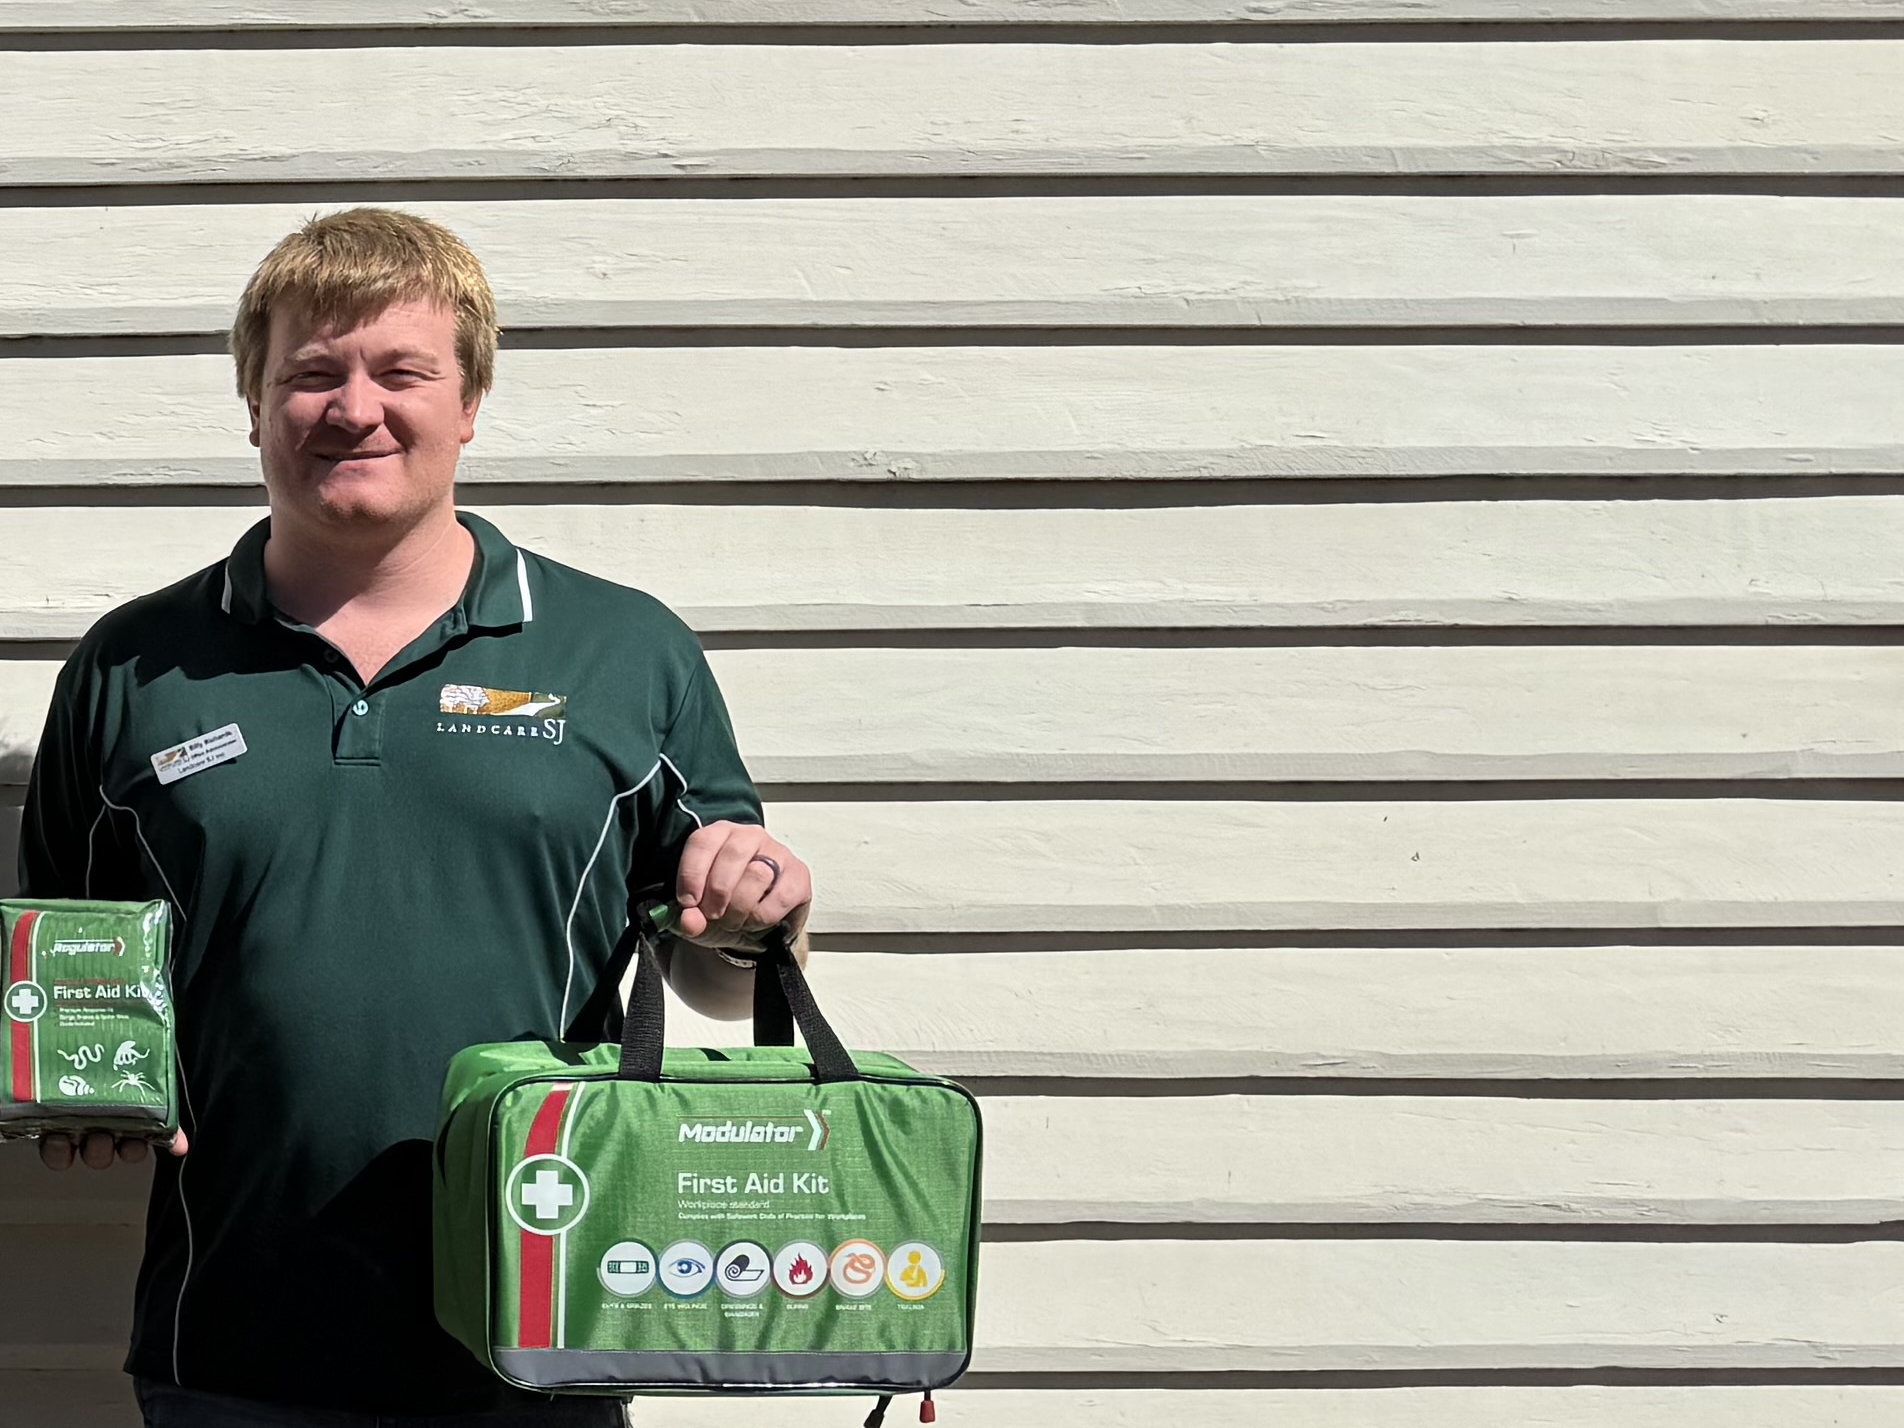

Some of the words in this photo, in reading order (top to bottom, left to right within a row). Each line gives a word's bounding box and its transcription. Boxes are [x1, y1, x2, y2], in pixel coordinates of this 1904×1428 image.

[436, 722, 539, 737] LANDCARE
[542, 718, 566, 745] SJ
[53, 985, 92, 999] First
[95, 984, 121, 999] Aid
[678, 1121, 804, 1143] Modulator
[677, 1172, 738, 1194] First
[744, 1172, 785, 1194] Aid
[793, 1172, 830, 1194] Kit
